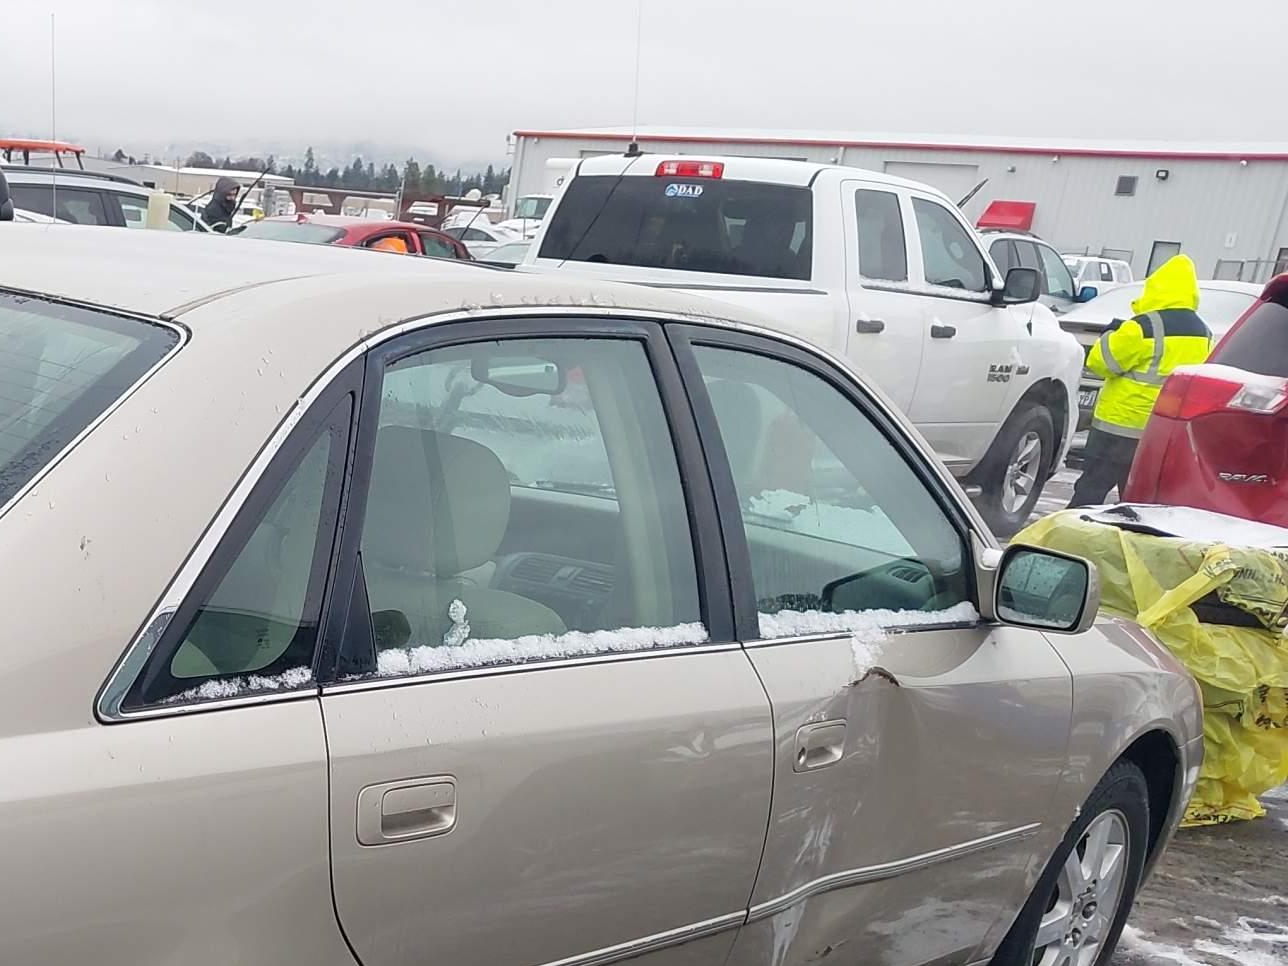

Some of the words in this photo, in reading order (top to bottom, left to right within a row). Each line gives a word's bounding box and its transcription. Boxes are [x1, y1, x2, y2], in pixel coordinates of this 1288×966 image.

[678, 184, 703, 196] DAD
[989, 364, 1013, 373] RAM
[987, 373, 1010, 383] 1500
